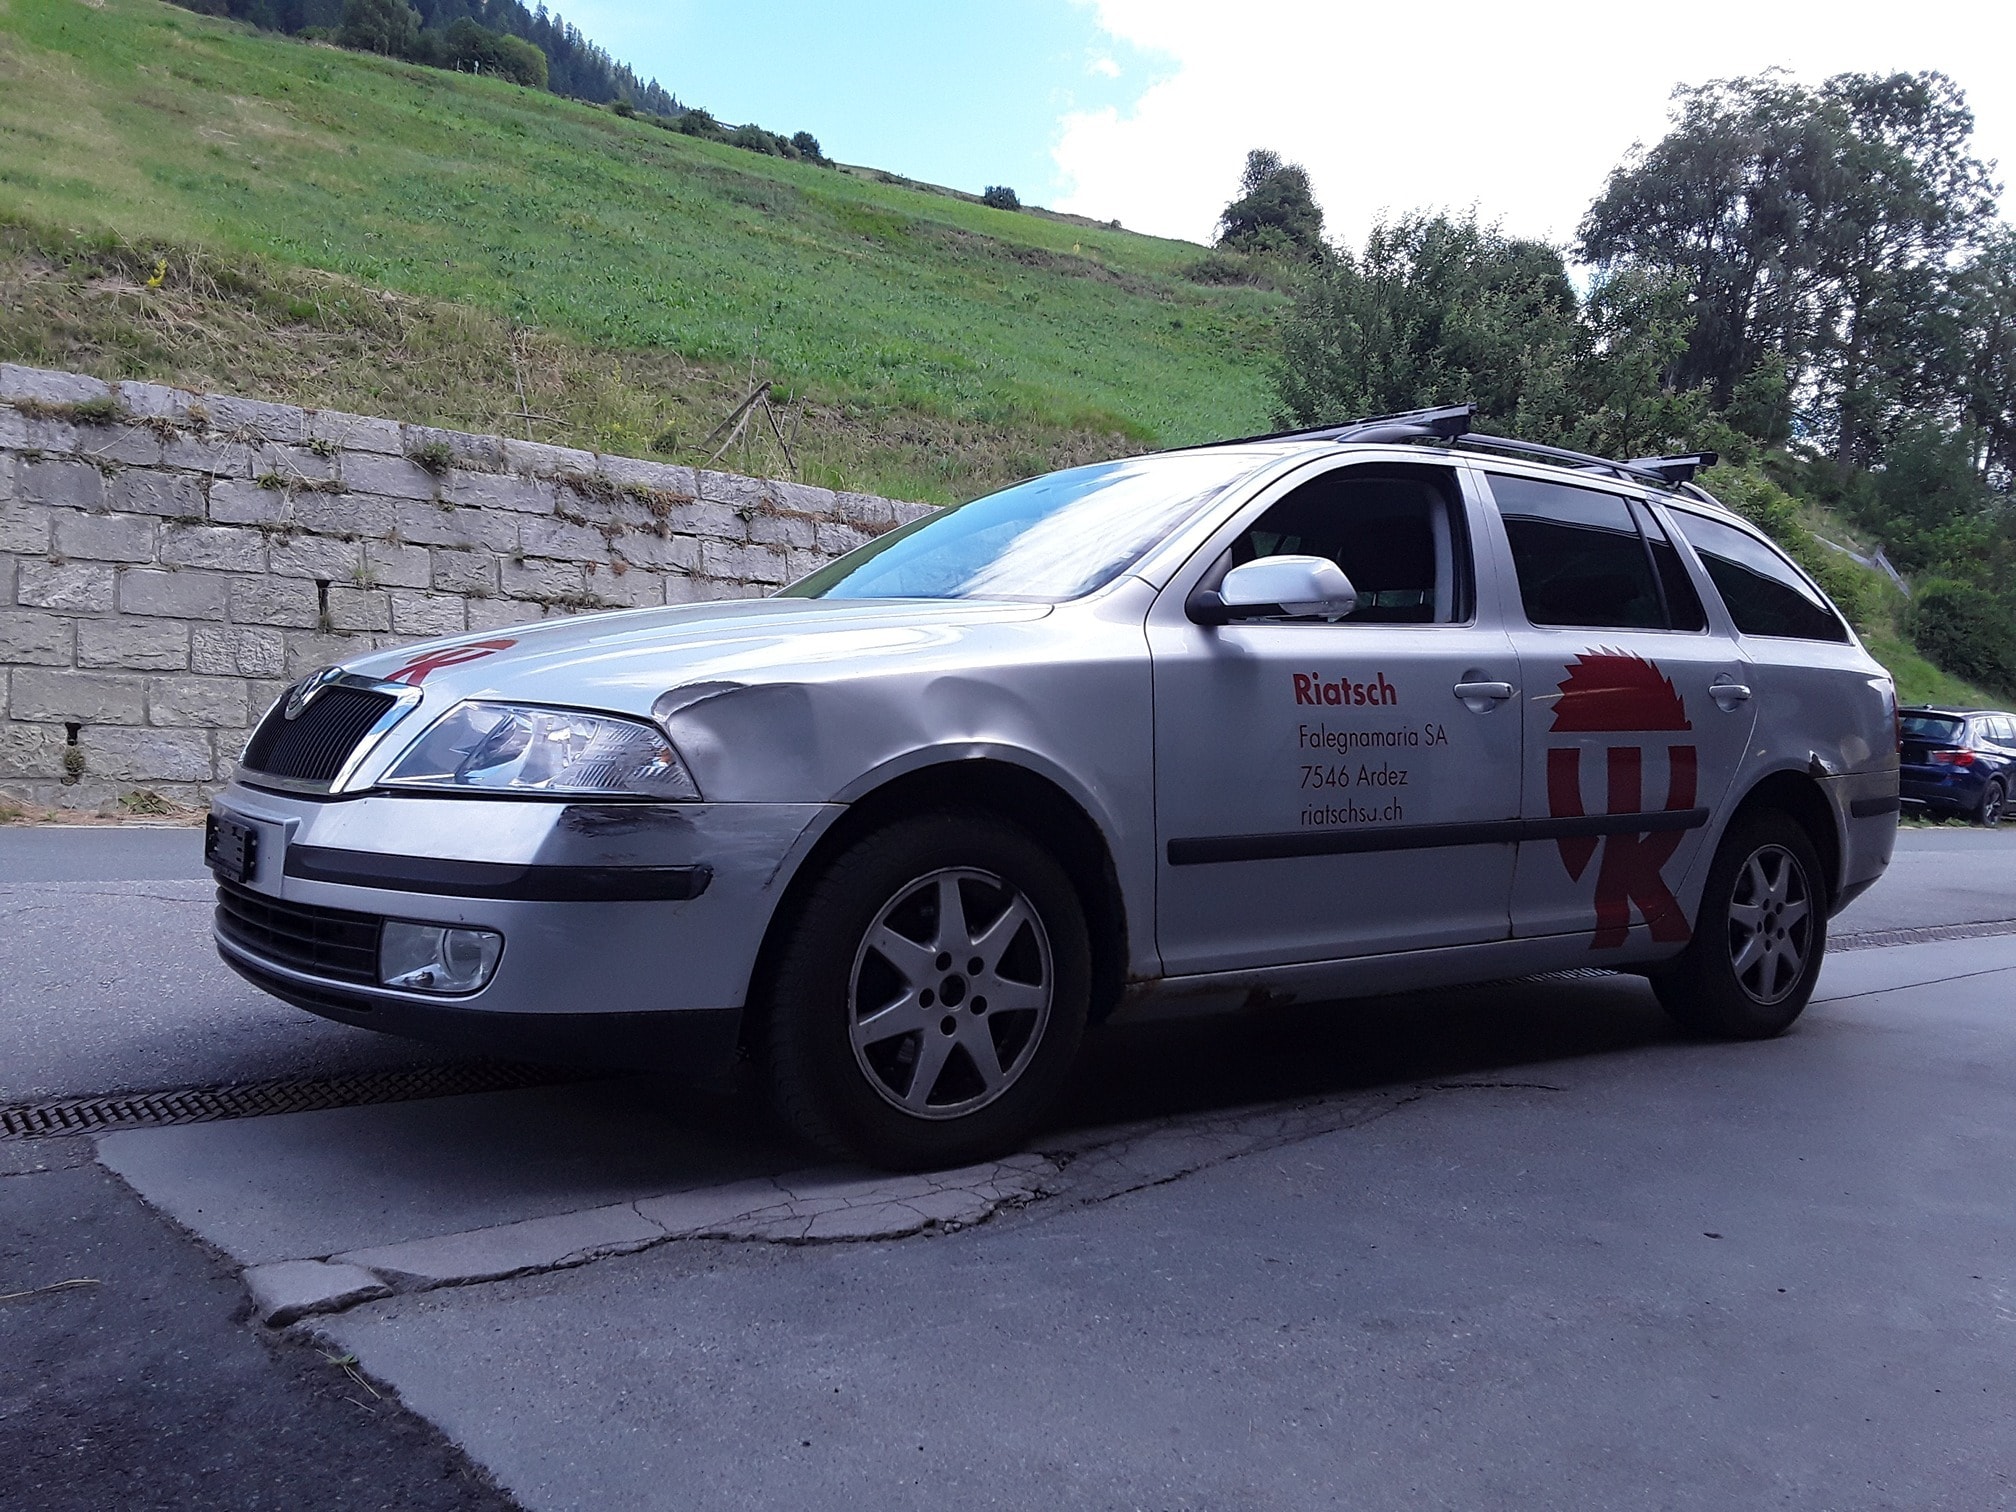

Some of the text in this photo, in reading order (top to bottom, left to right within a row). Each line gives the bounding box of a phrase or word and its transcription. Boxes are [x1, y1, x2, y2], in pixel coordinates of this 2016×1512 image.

[1293, 672, 1397, 705] Riatsch
[1300, 723, 1448, 754] Falegnamaria SA
[1301, 762, 1408, 789] 7546 Ardez
